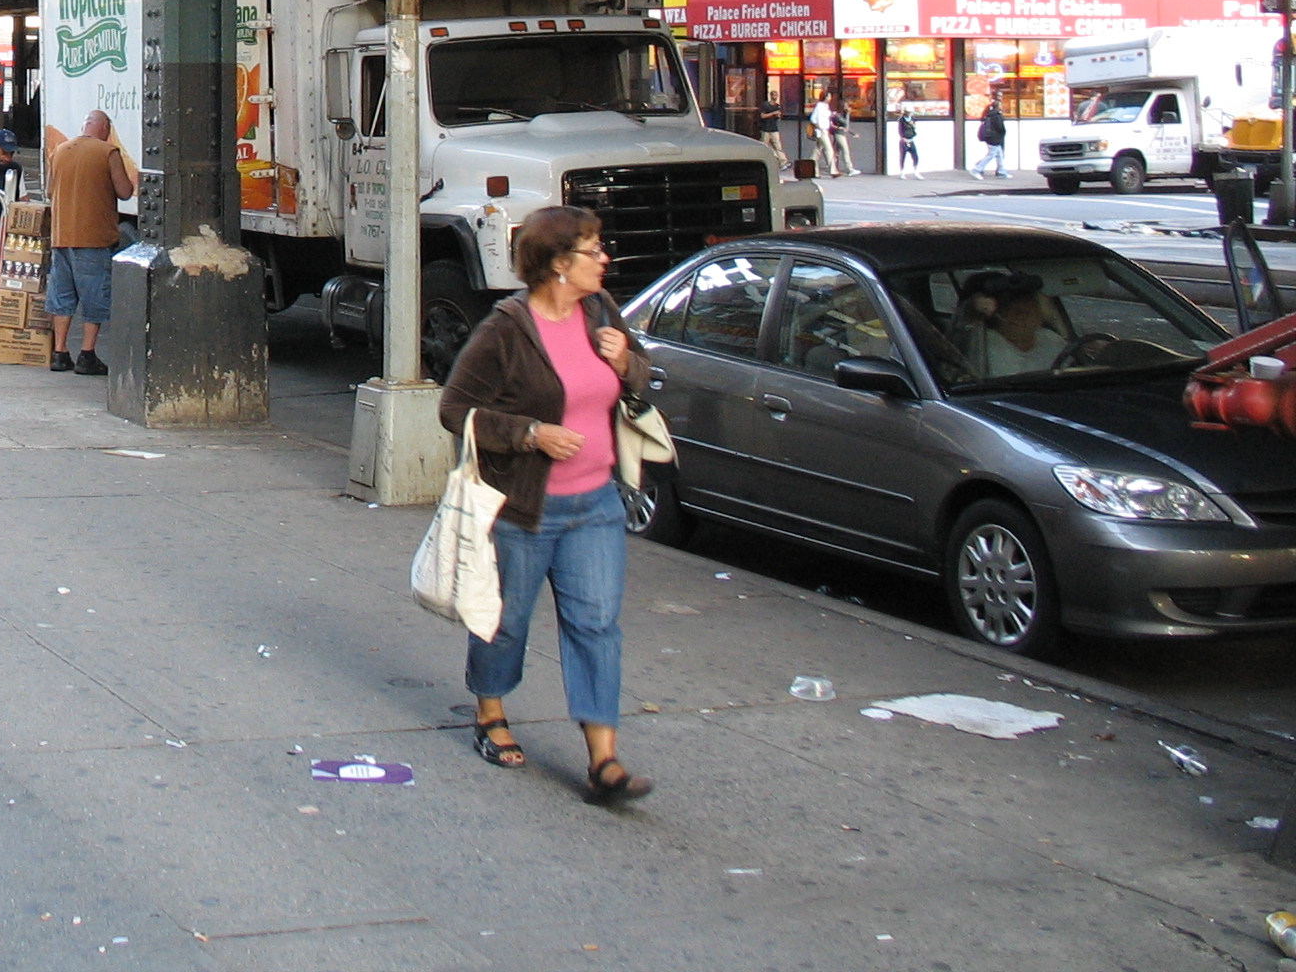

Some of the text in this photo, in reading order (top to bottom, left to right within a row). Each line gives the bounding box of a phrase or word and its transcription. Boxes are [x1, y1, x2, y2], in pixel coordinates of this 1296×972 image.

[707, 2, 811, 21] Palace Fried Chicken
[692, 23, 723, 39] PIZZA
[730, 22, 770, 38] BURGER
[779, 20, 828, 37] CHICKEN
[930, 16, 982, 35] PIZZA
[995, 17, 1062, 36] BURGER
[62, 28, 122, 68] PURE PREMIUM
[97, 83, 140, 113] Perfect.
